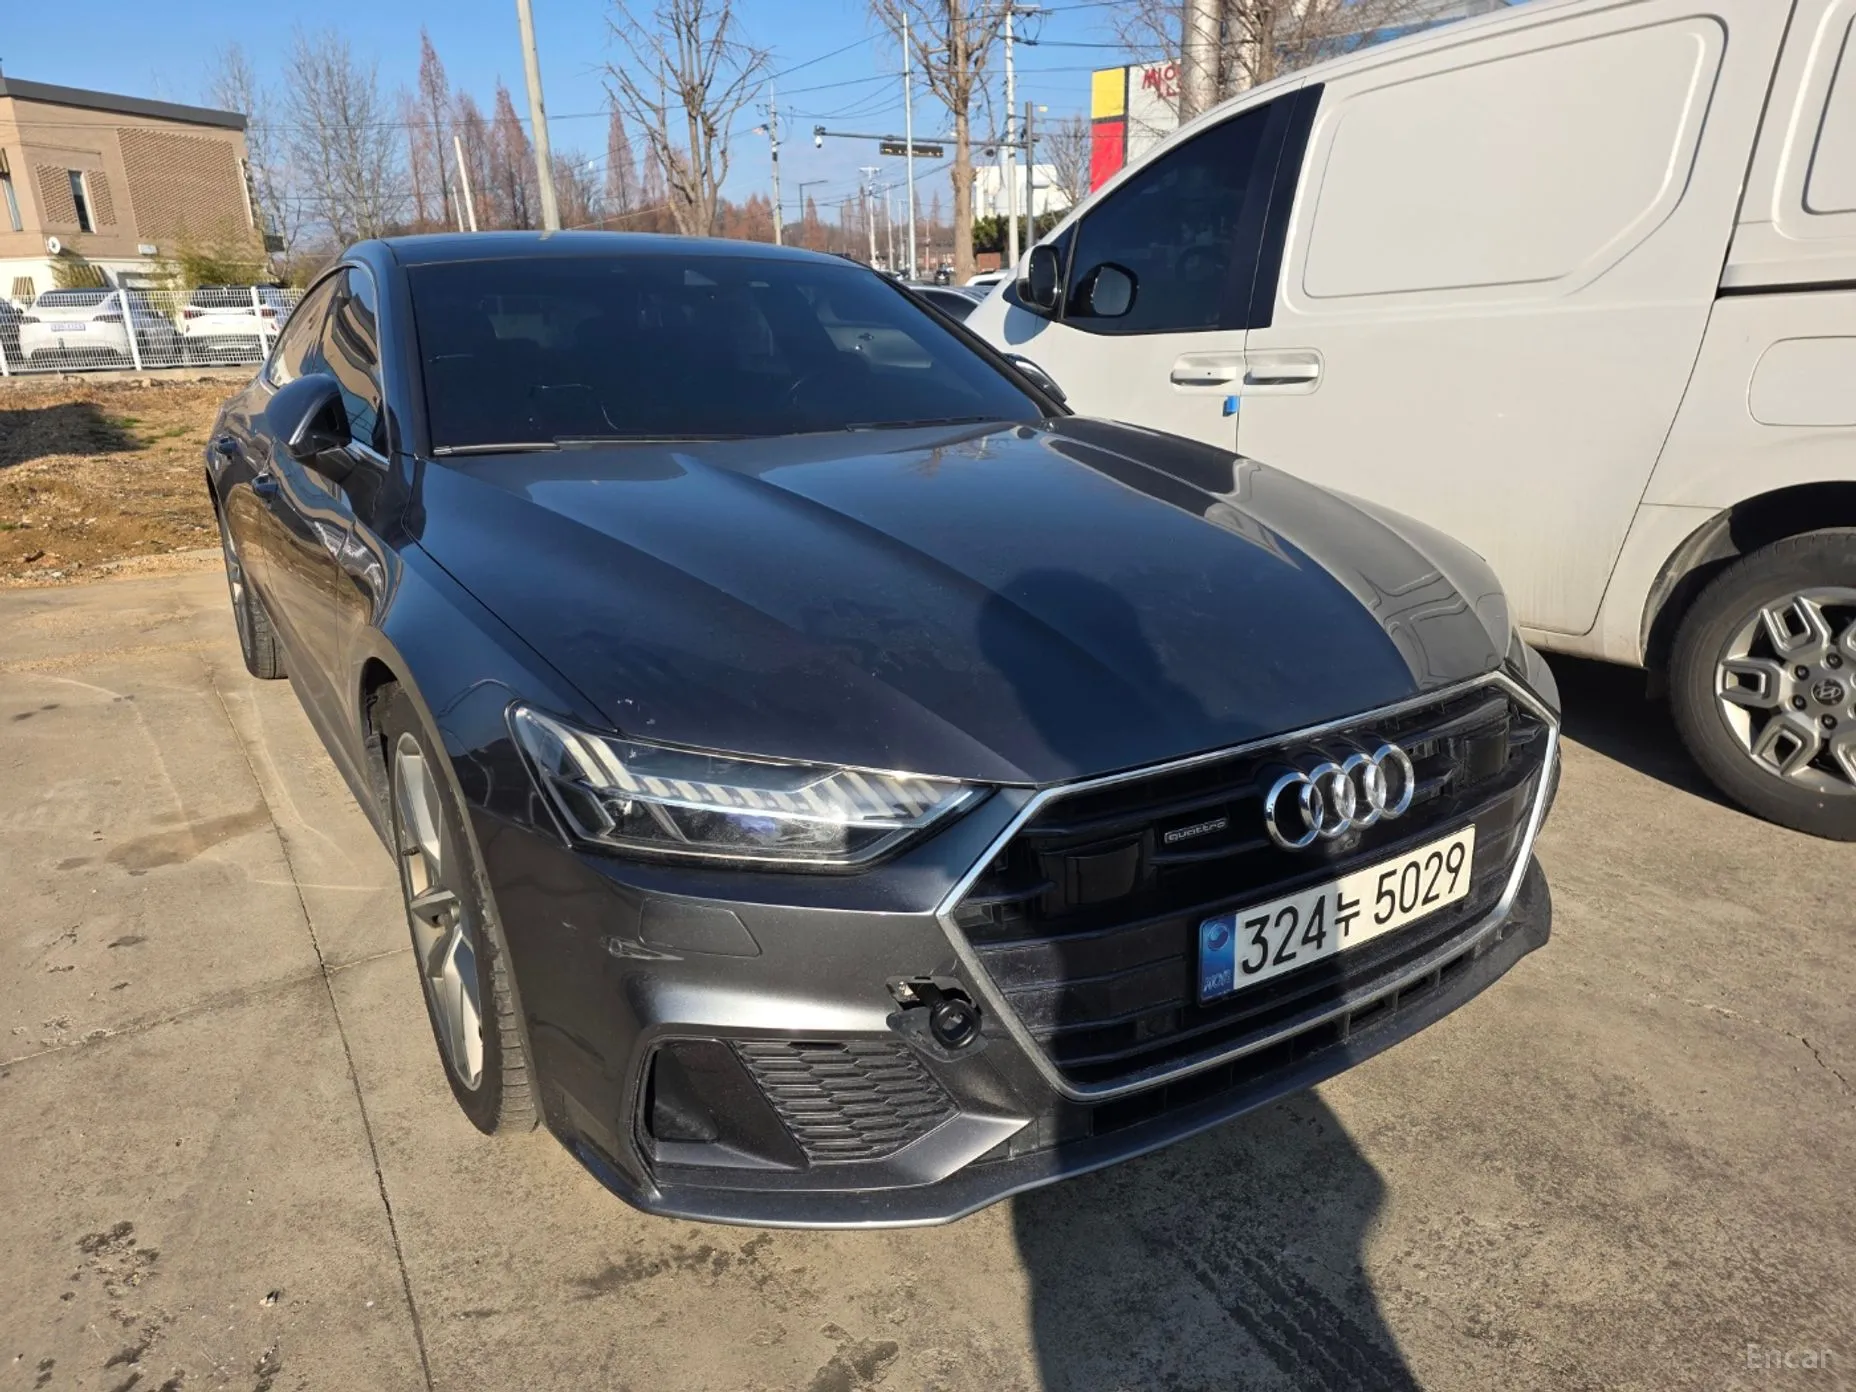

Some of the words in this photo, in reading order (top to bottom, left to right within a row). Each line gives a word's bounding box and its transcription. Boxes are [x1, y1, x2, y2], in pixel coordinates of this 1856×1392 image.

[1167, 819, 1227, 842] quattro
[1241, 892, 1361, 975] 324누
[1373, 841, 1466, 925] 5029
